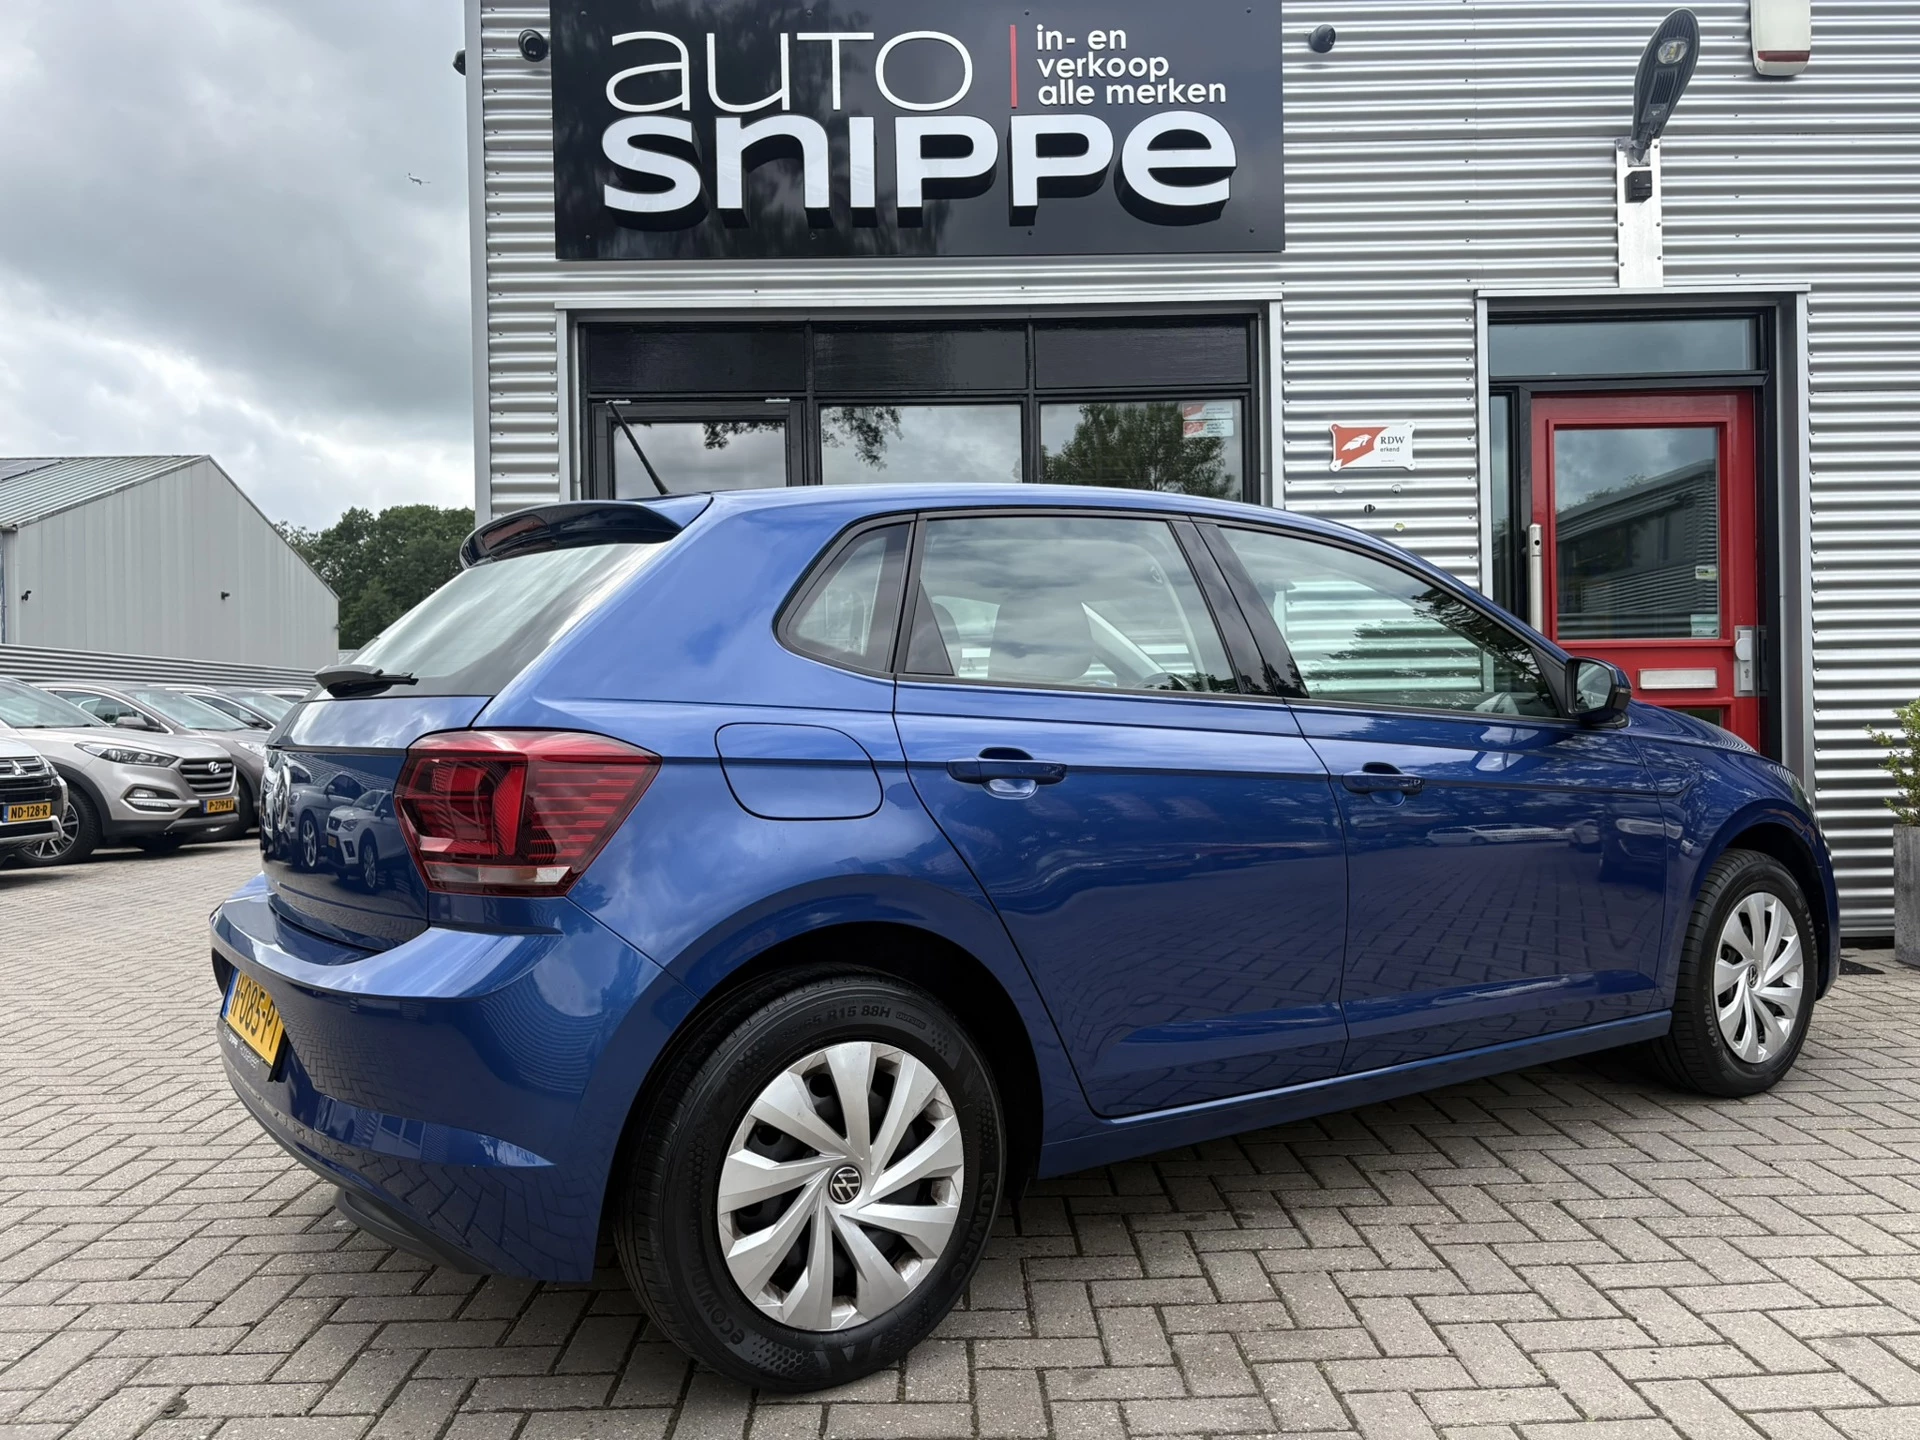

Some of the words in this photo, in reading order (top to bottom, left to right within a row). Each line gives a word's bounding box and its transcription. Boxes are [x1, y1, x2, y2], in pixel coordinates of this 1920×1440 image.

[1036, 24, 1076, 50] in-
[1087, 30, 1127, 50] en
[1036, 51, 1169, 82] verkoop
[1038, 79, 1095, 105] alle
[1106, 78, 1226, 104] merken
[1380, 436, 1405, 444] RDW
[11, 805, 48, 819] ND-128-R
[827, 1005, 857, 1021] R15
[861, 1005, 892, 1018] 88H
[950, 1172, 997, 1281] KUMHO
